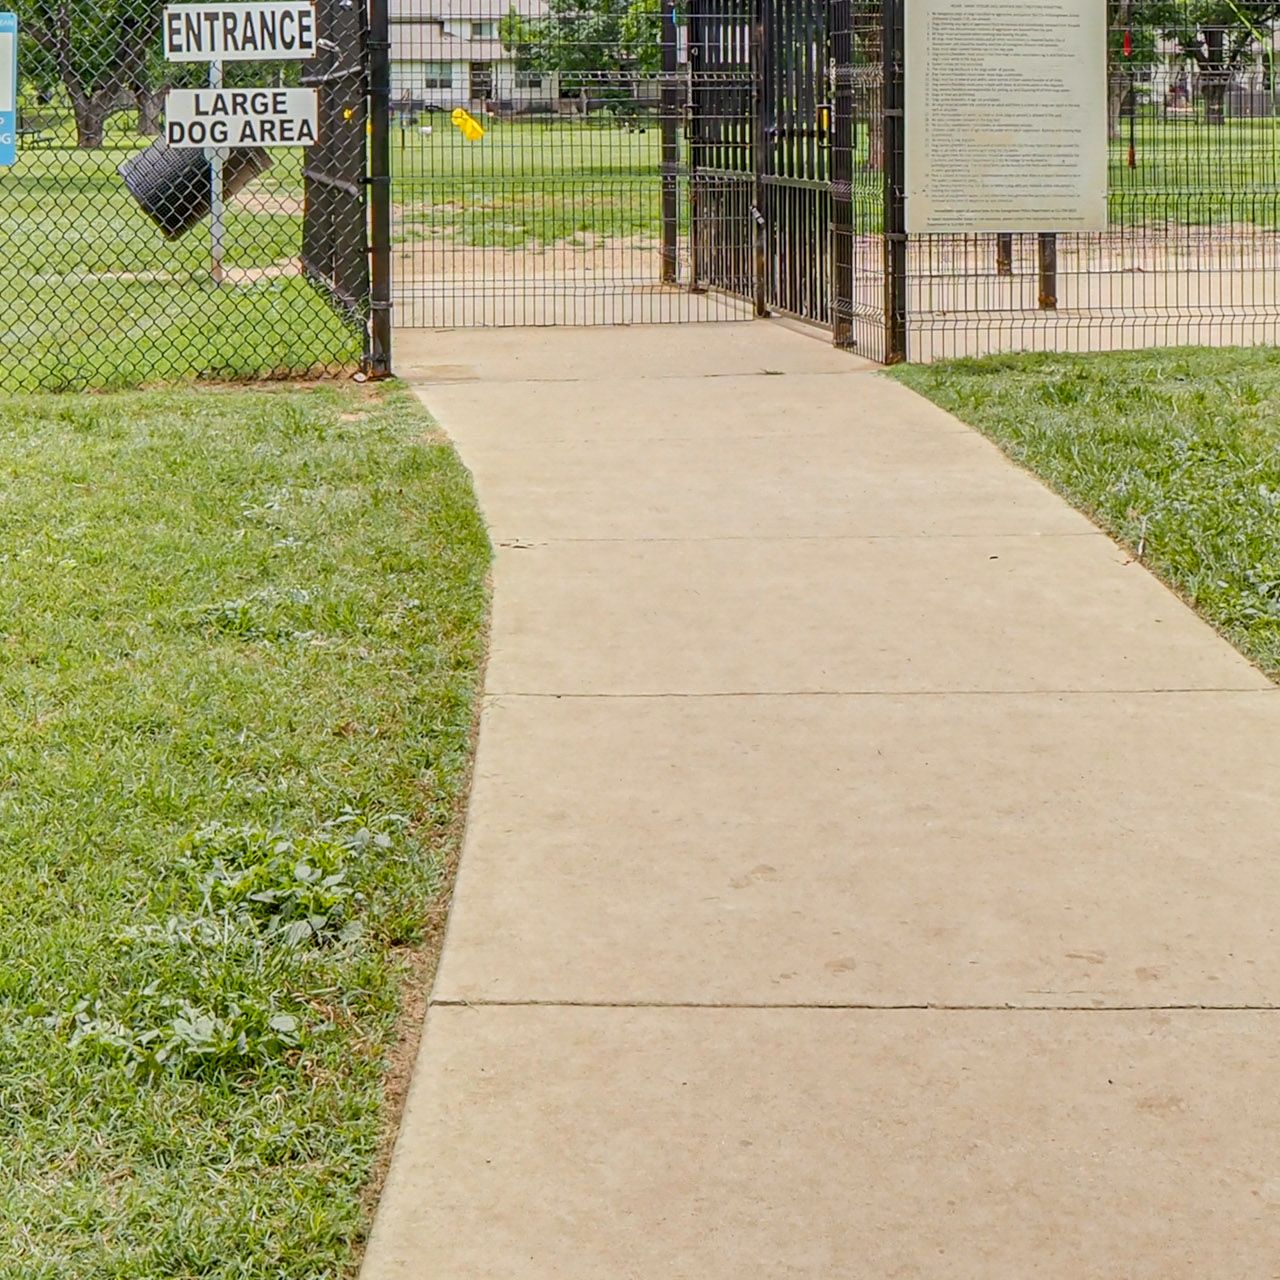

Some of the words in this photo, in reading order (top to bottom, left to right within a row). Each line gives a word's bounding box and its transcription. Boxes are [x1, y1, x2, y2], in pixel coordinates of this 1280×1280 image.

[167, 10, 313, 53] ENTRANCE
[194, 92, 288, 116] LARGE
[169, 120, 228, 144] DOG
[239, 118, 314, 142] AREA
